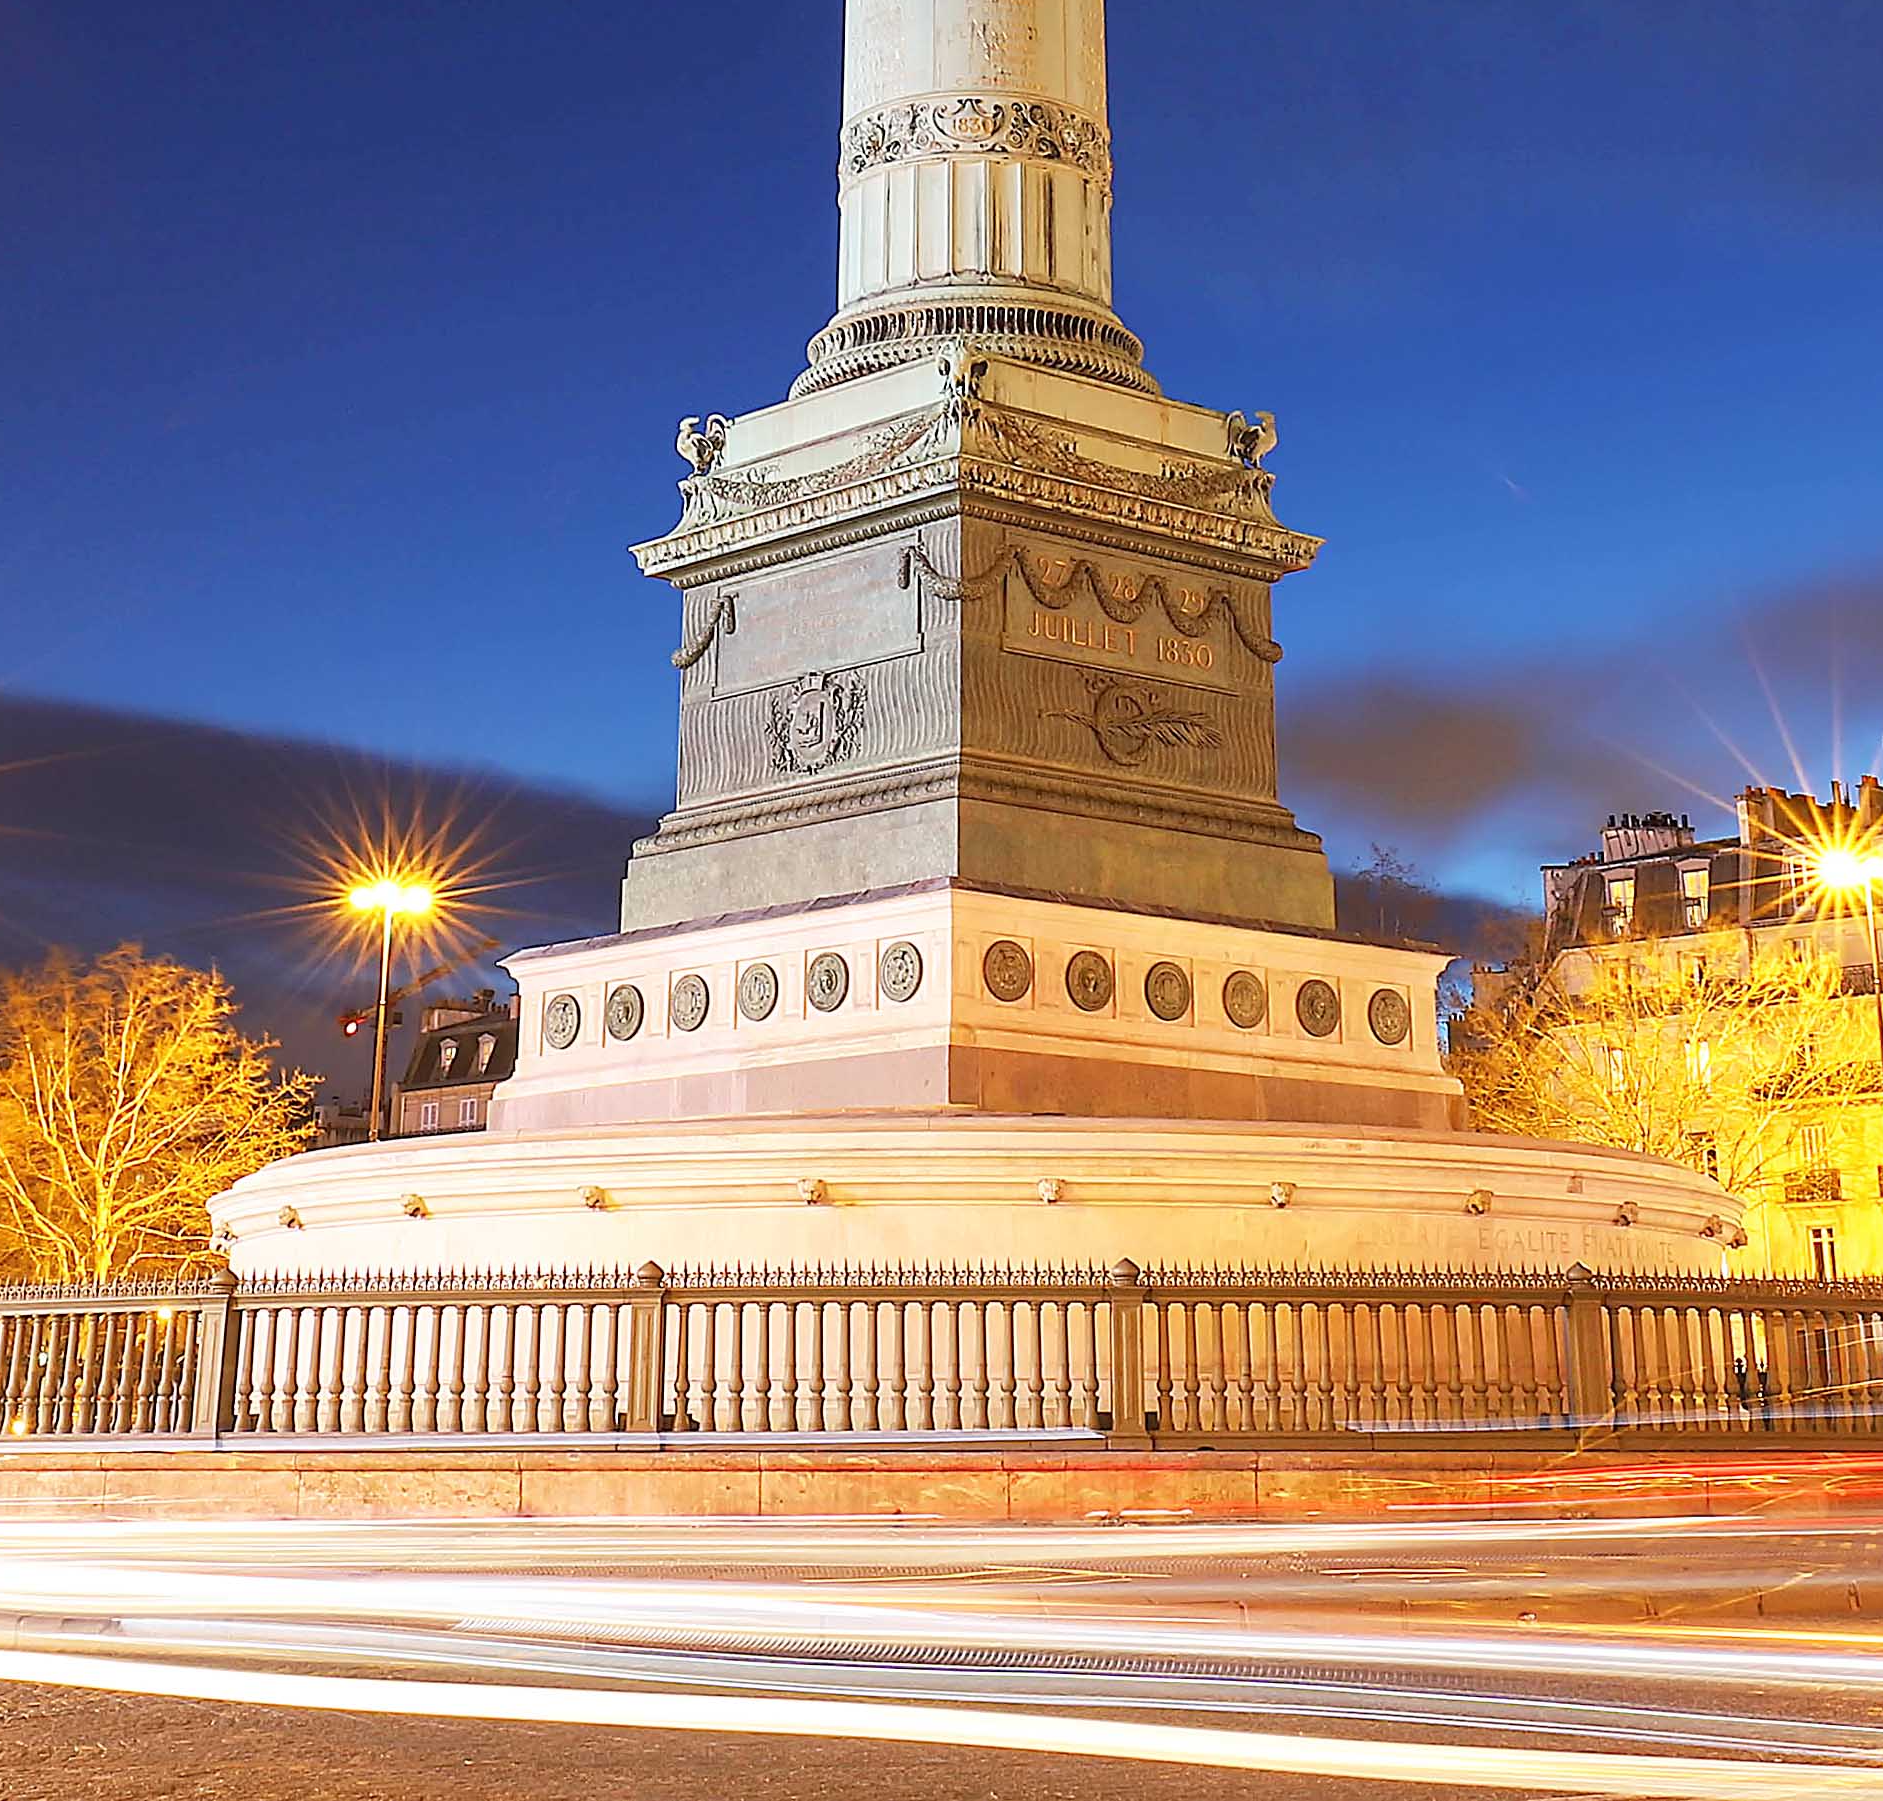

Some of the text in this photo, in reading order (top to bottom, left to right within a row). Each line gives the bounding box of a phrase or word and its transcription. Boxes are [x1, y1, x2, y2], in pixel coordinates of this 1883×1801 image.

[1038, 557, 1204, 614] 27 28 29
[1028, 611, 1213, 671] JUILLET 1830
[1478, 1227, 1571, 1253] EGALITE
